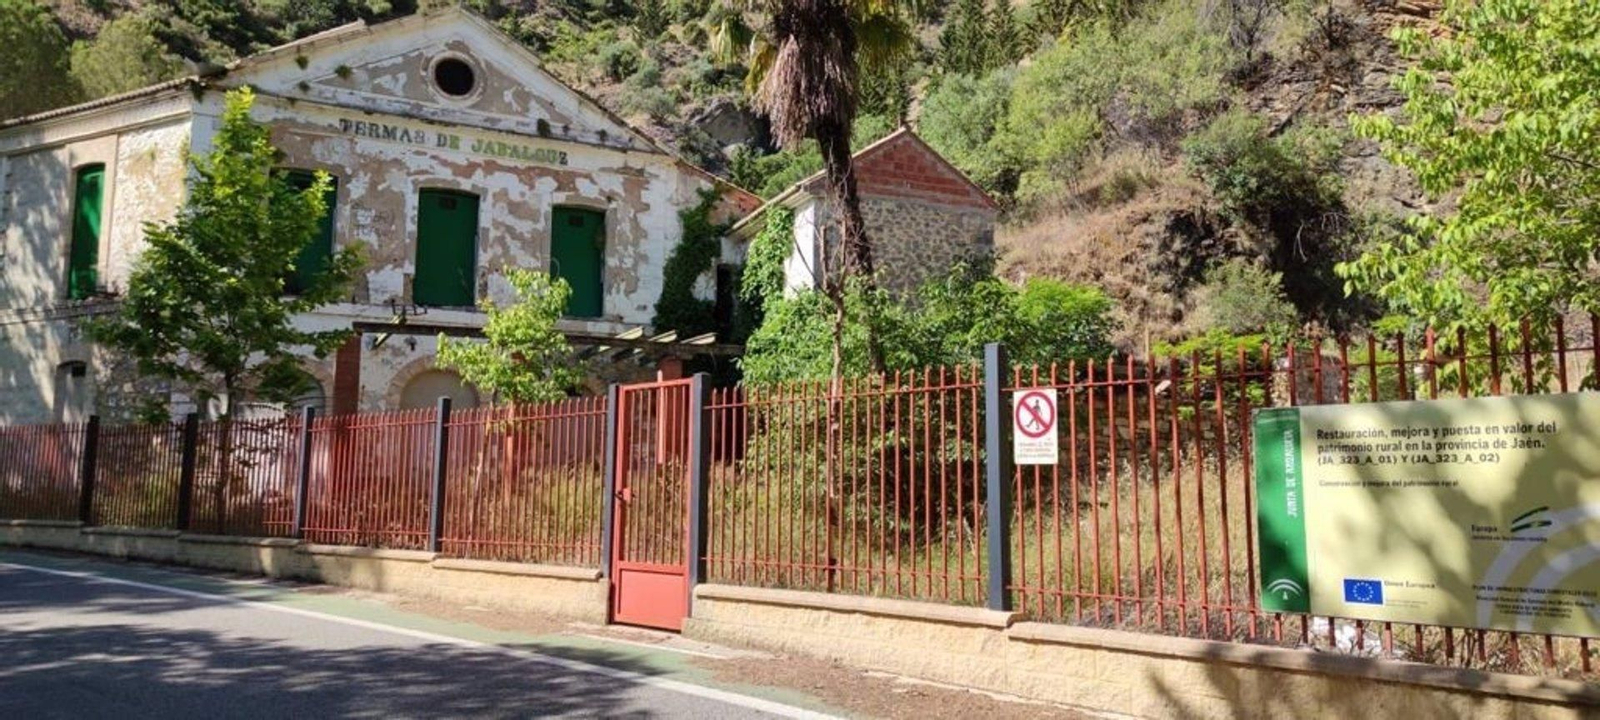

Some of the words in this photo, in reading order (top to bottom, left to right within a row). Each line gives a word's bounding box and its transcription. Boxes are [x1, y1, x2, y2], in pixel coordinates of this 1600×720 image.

[338, 117, 426, 144] TERMAS
[436, 132, 460, 150] DE
[1316, 427, 1389, 440] Restauración,
[1391, 426, 1430, 439] mejora
[1432, 427, 1440, 438] y
[1441, 425, 1481, 438] puesta
[1485, 425, 1501, 435] en
[1502, 422, 1534, 435] valor
[1537, 420, 1557, 434] del
[1317, 443, 1373, 455] patrimonio
[1376, 440, 1403, 452] rural
[1405, 441, 1419, 451] en
[1421, 440, 1432, 451] la
[1435, 438, 1489, 452] provincia
[1493, 437, 1507, 449] de
[1511, 436, 1546, 449] Jaén.
[1318, 454, 1398, 466] (JA323_A_01)
[1401, 454, 1409, 463] Y
[1286, 473, 1296, 488] DE
[1286, 490, 1298, 519] JUNTA
